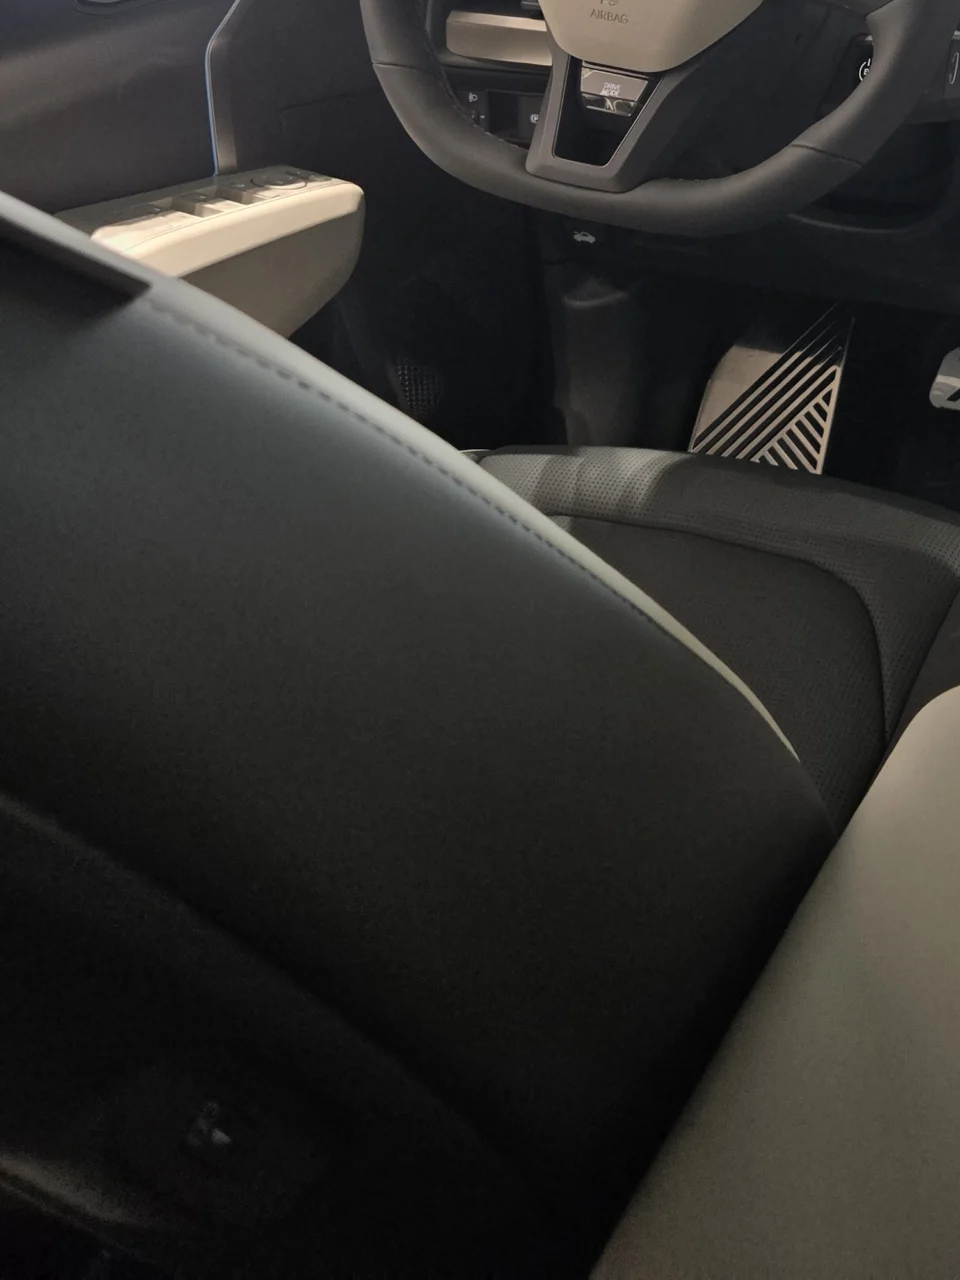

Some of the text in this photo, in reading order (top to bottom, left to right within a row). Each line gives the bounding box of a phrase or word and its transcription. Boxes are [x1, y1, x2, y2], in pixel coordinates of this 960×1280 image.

[590, 8, 629, 24] AIRBAG
[603, 81, 622, 91] DRIVE
[600, 89, 620, 97] MODE
